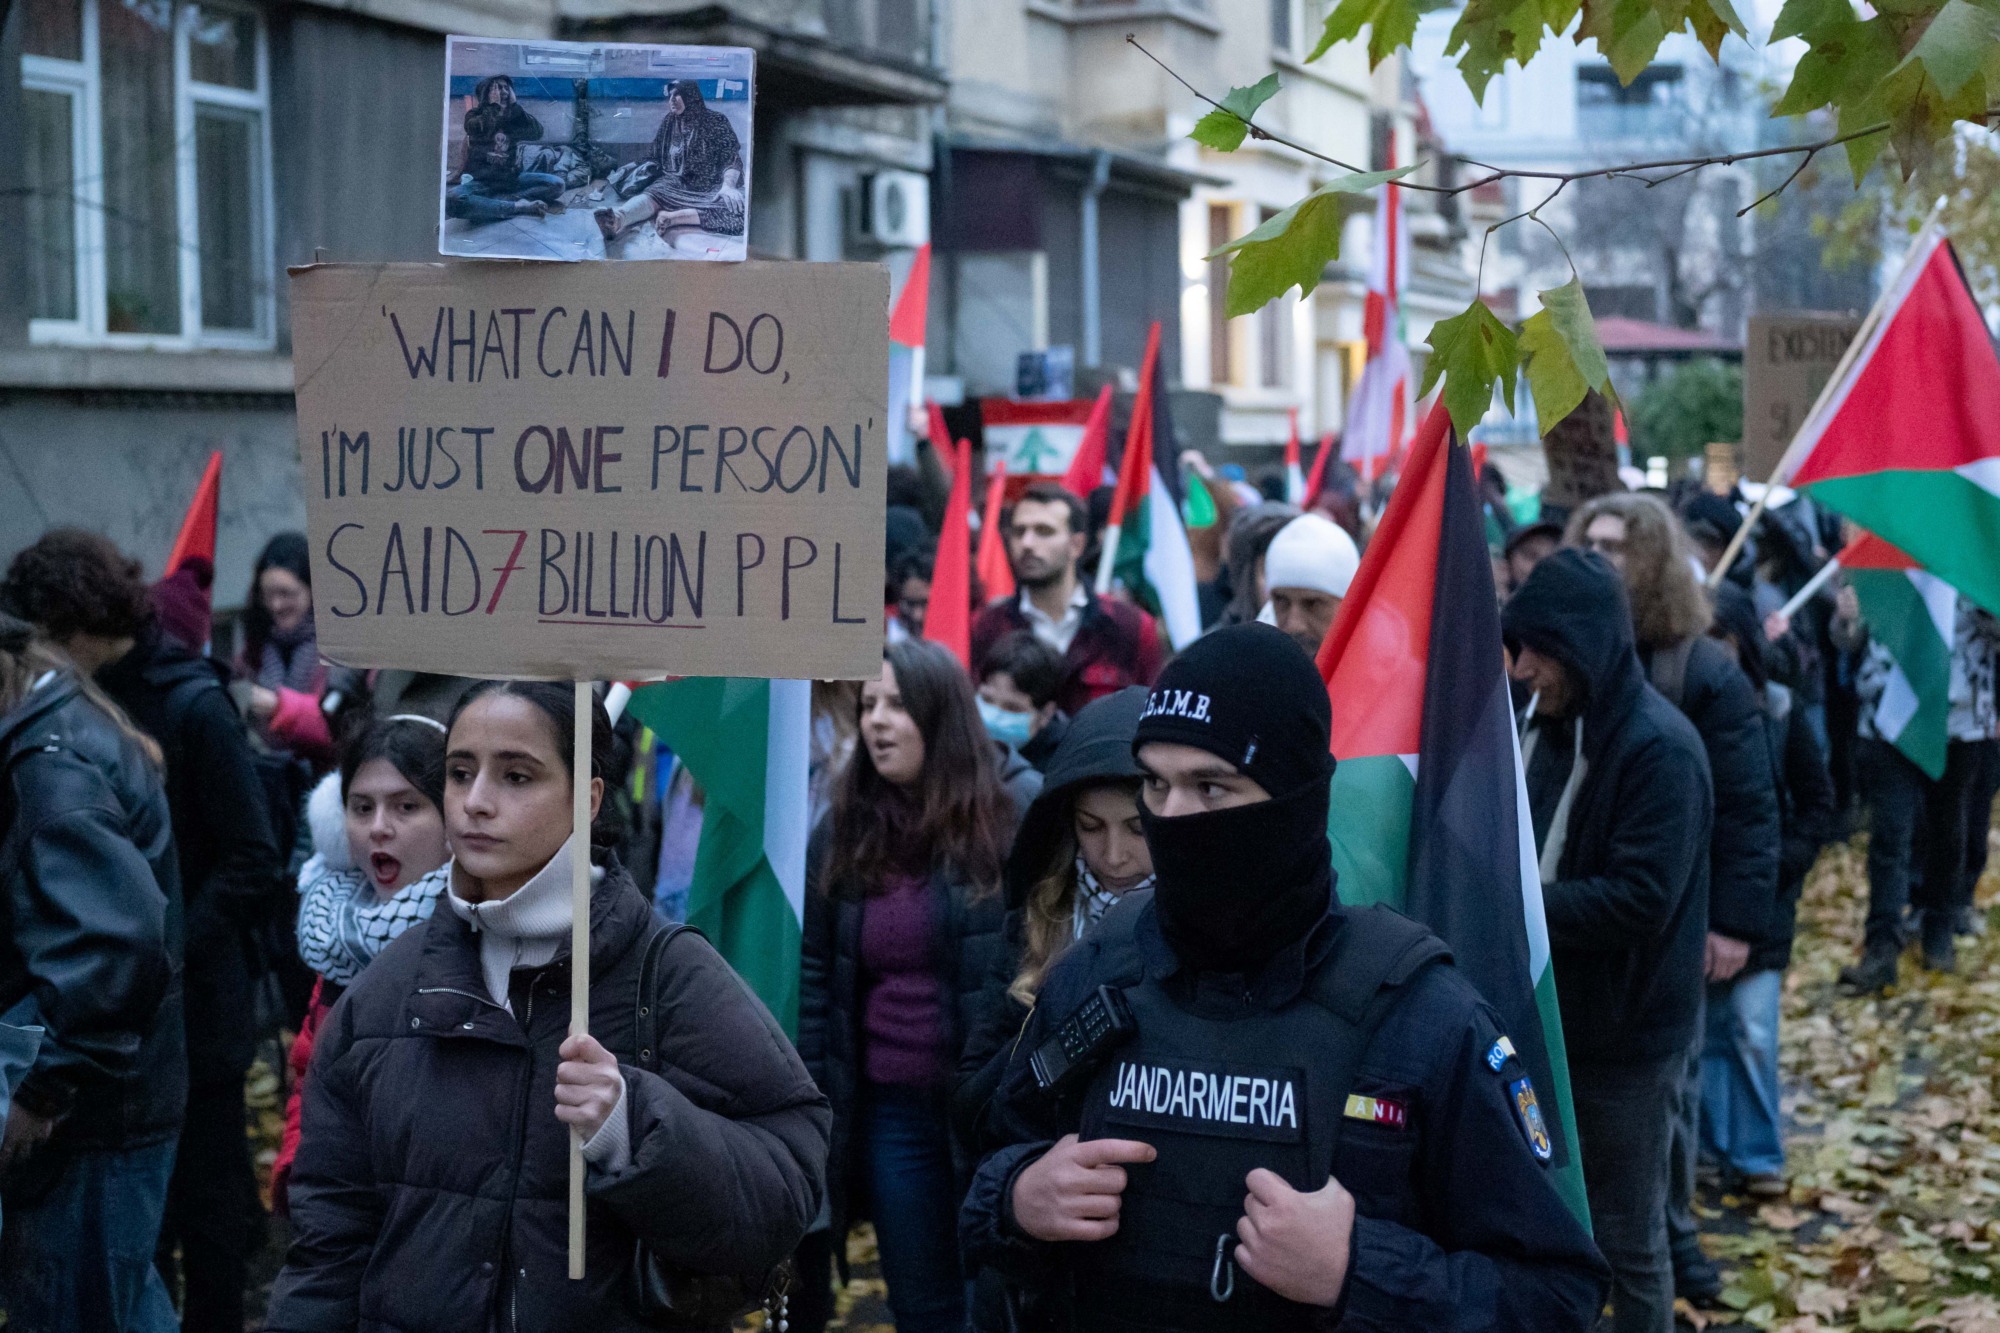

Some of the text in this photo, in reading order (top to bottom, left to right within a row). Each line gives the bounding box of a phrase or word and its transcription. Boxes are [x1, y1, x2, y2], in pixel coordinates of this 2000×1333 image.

[657, 308, 677, 379] I
[703, 311, 790, 384] DO,
[321, 418, 874, 499] I'M JUST ONE PERSON'
[326, 522, 481, 618] SAID
[481, 529, 528, 615] 7
[537, 528, 707, 625] BILLION
[1109, 1061, 1297, 1129] JANDARMERIA
